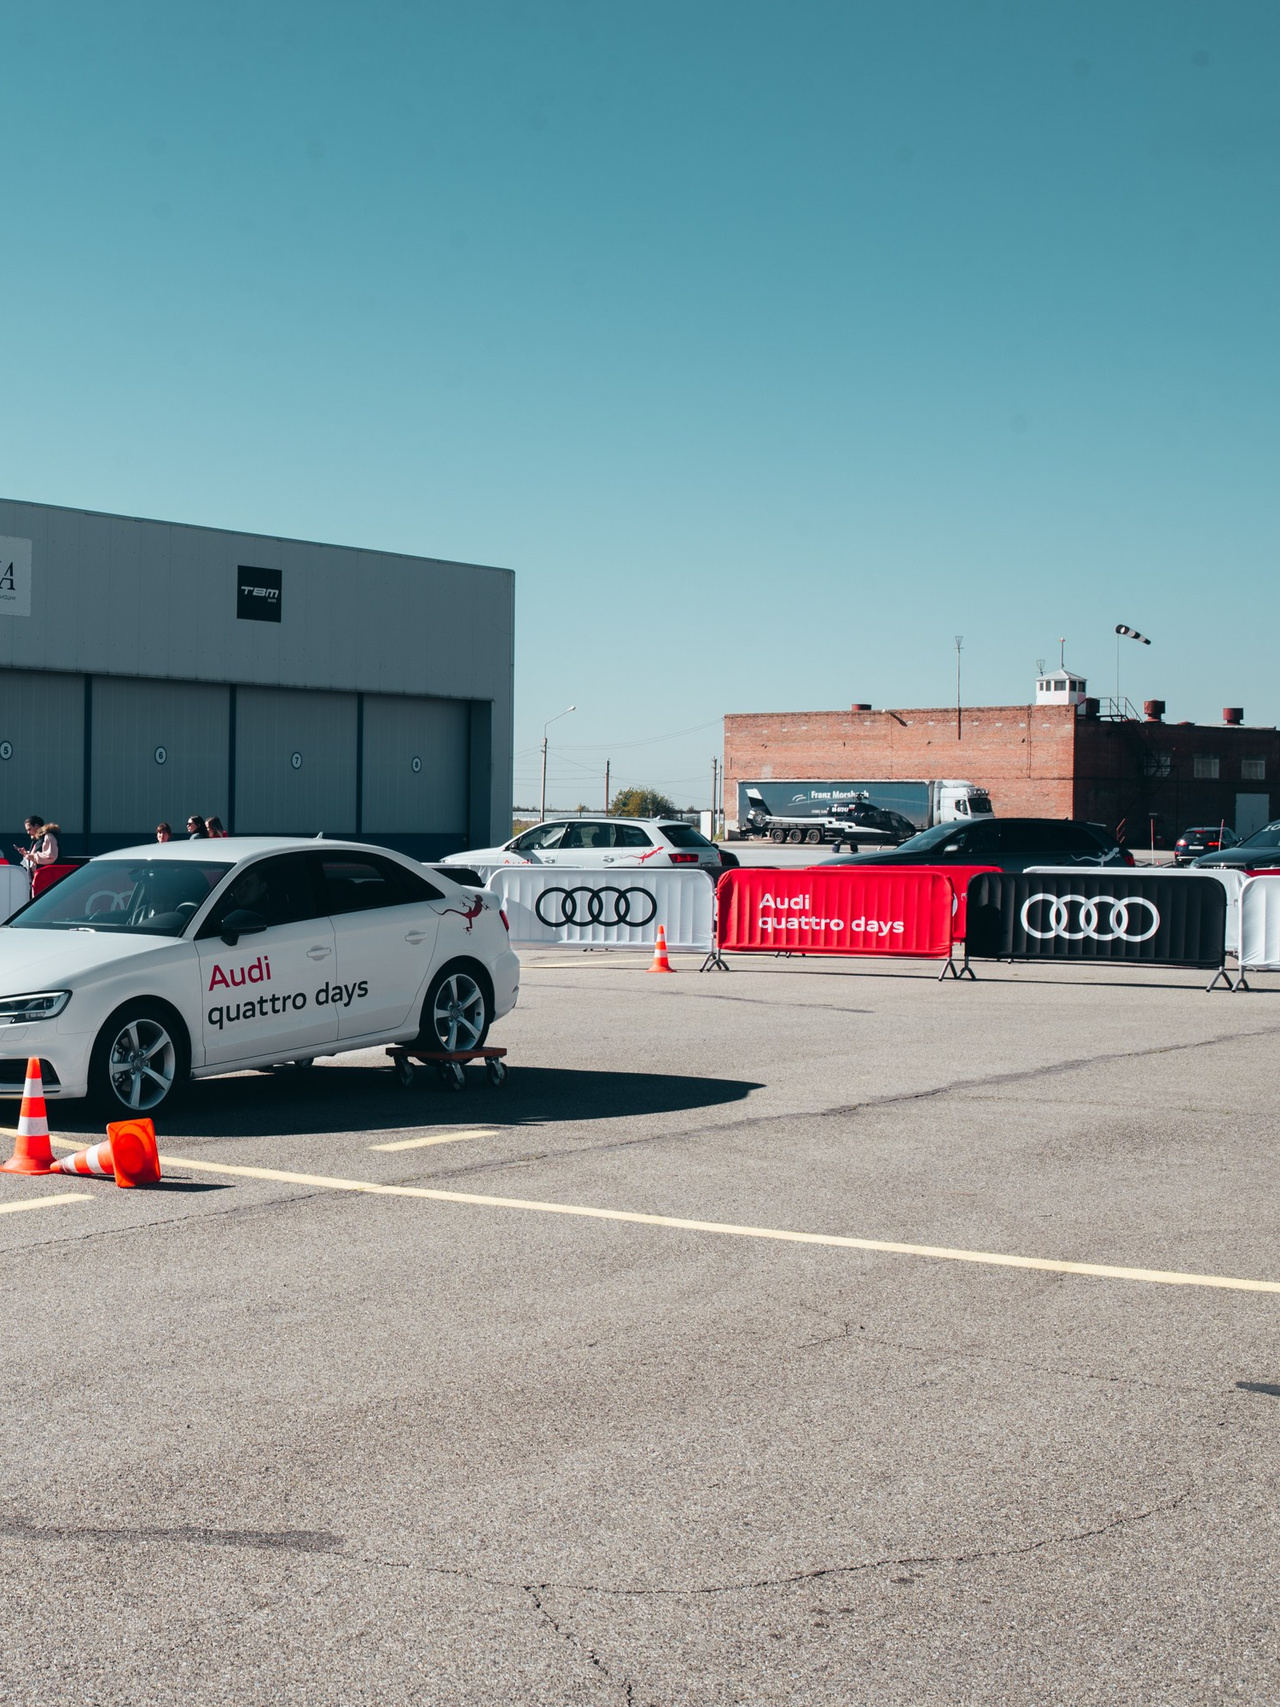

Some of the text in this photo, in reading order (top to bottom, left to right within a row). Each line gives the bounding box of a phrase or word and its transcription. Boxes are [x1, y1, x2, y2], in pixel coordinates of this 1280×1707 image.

[240, 586, 279, 598] TBM
[811, 790, 831, 799] Franz
[759, 893, 810, 910] Audi
[758, 915, 905, 937] quattro days
[208, 955, 271, 992] Audi
[207, 980, 369, 1030] quattro days
